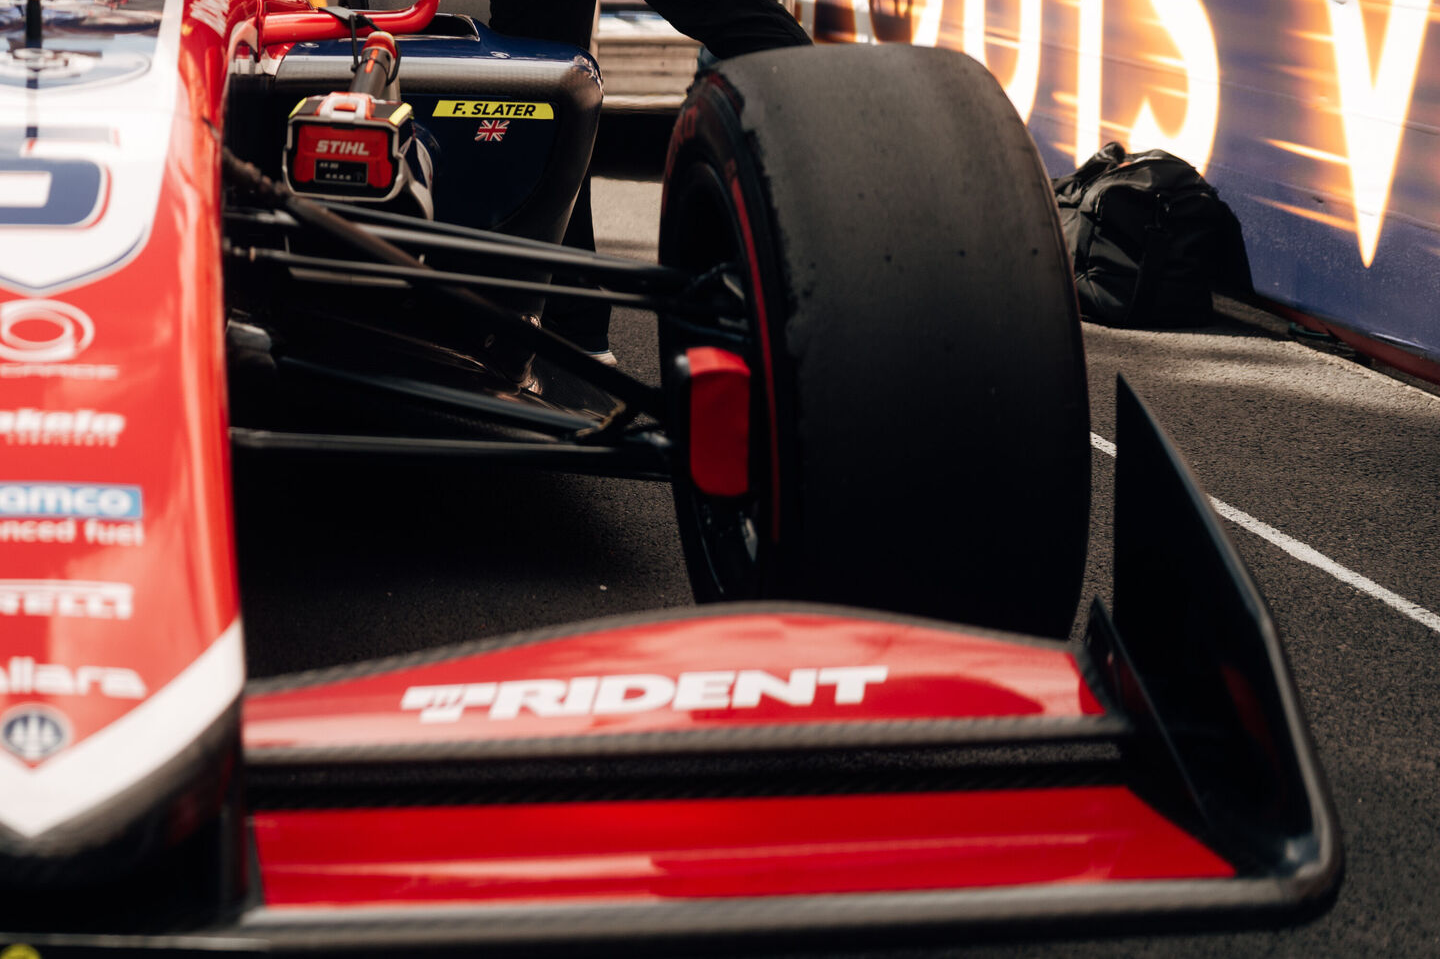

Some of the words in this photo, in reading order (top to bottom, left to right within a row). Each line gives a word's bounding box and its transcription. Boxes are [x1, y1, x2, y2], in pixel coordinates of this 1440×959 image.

[452, 102, 467, 115] F.
[471, 102, 537, 117] SLATER
[315, 140, 370, 156] STIHL
[83, 518, 145, 547] fuel
[399, 665, 891, 724] TRIDENT
